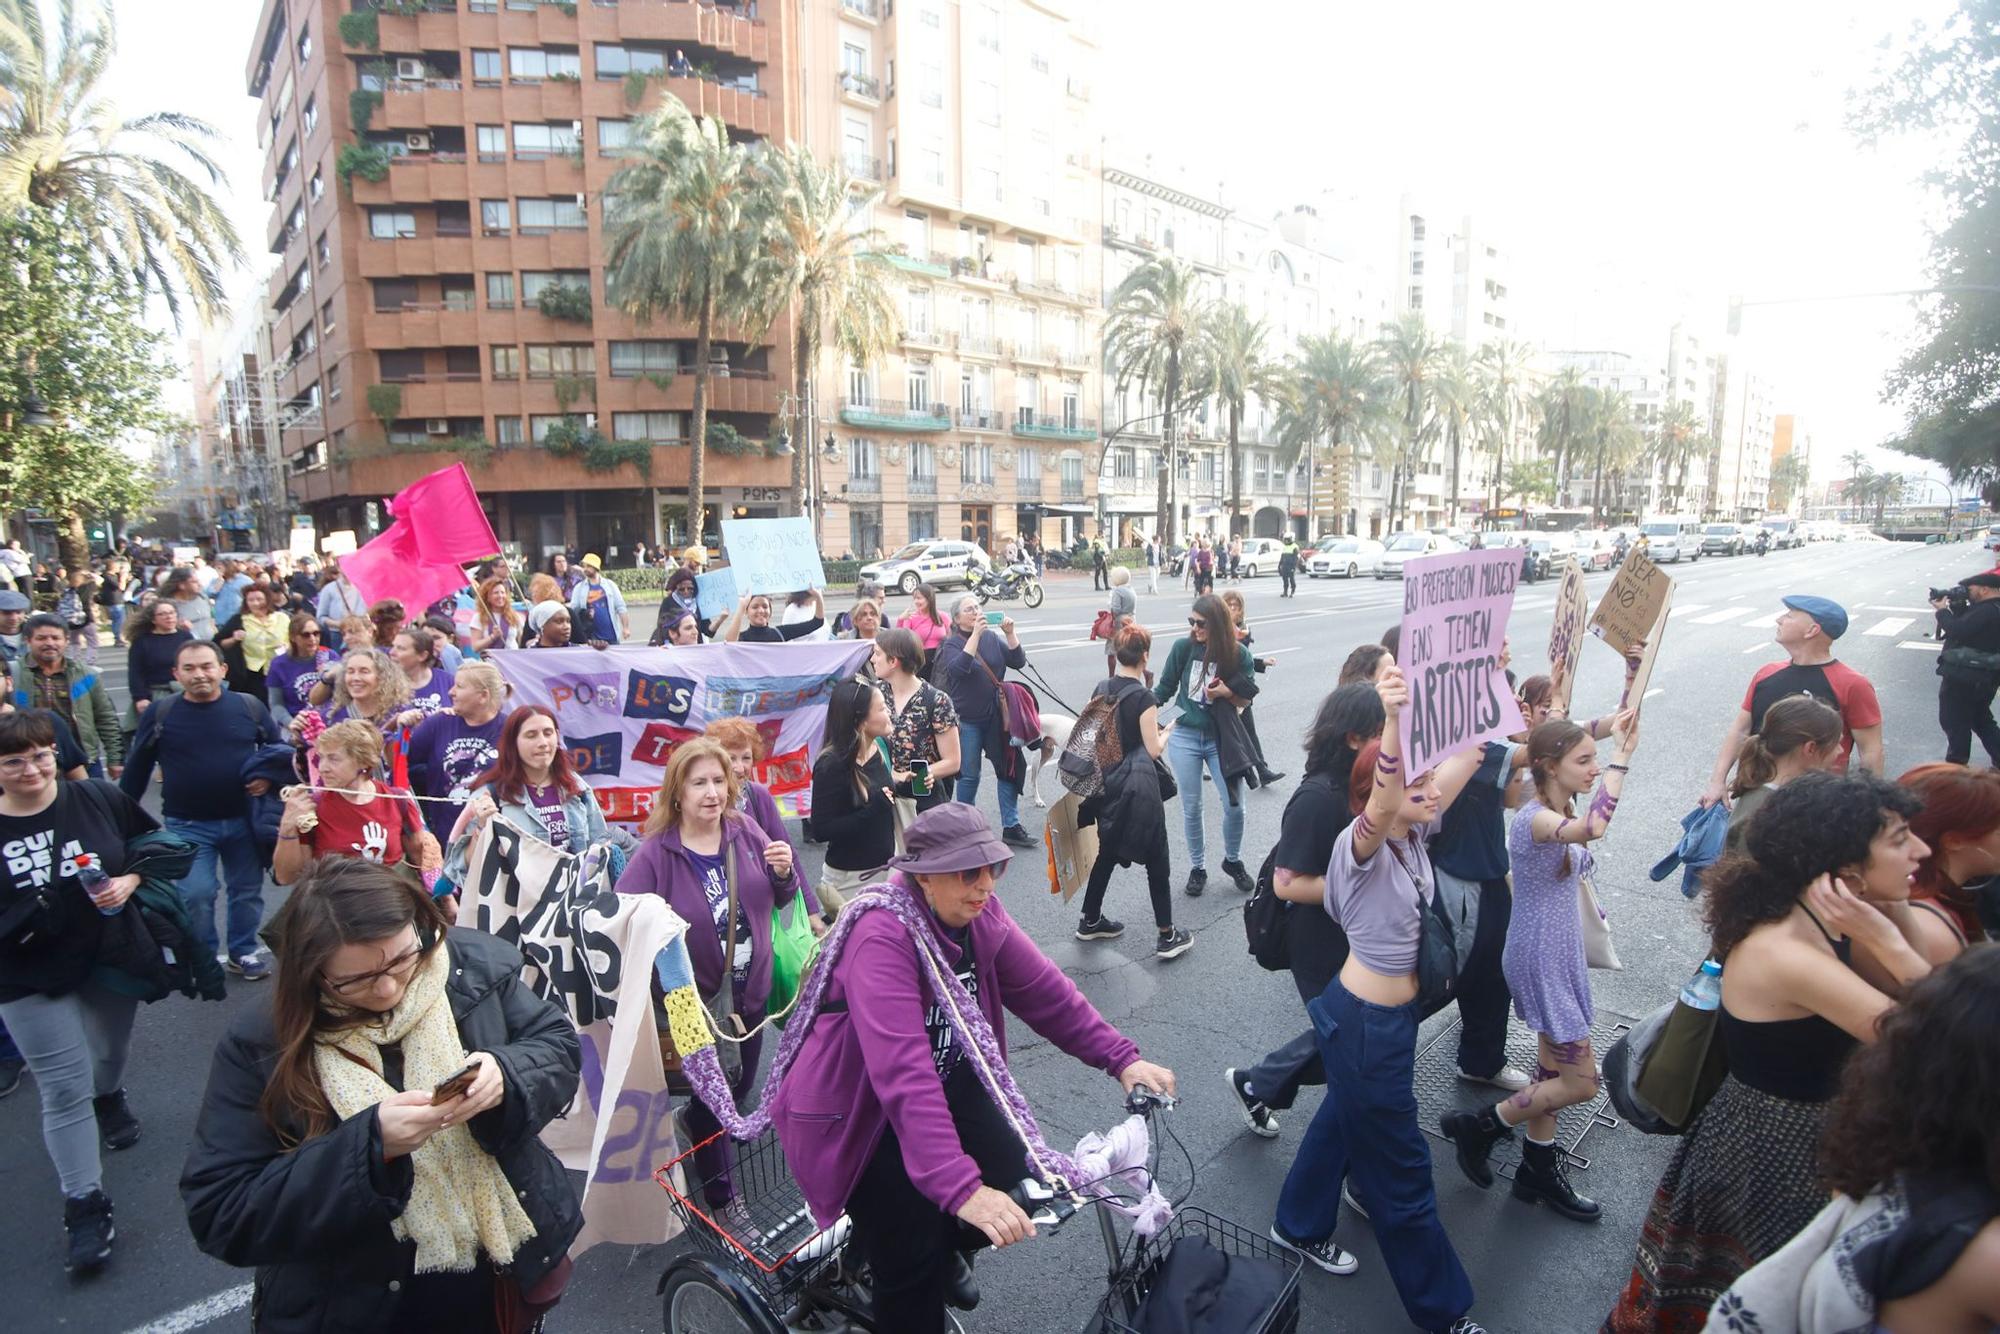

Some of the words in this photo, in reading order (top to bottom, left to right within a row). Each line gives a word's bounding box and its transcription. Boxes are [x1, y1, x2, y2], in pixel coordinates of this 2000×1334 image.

[1628, 554, 1657, 585] SER
[1412, 625, 1433, 666] ENS
[1445, 608, 1492, 656] TEMEN
[552, 681, 618, 711] POR
[634, 678, 691, 713] LOS
[574, 744, 612, 772] DE
